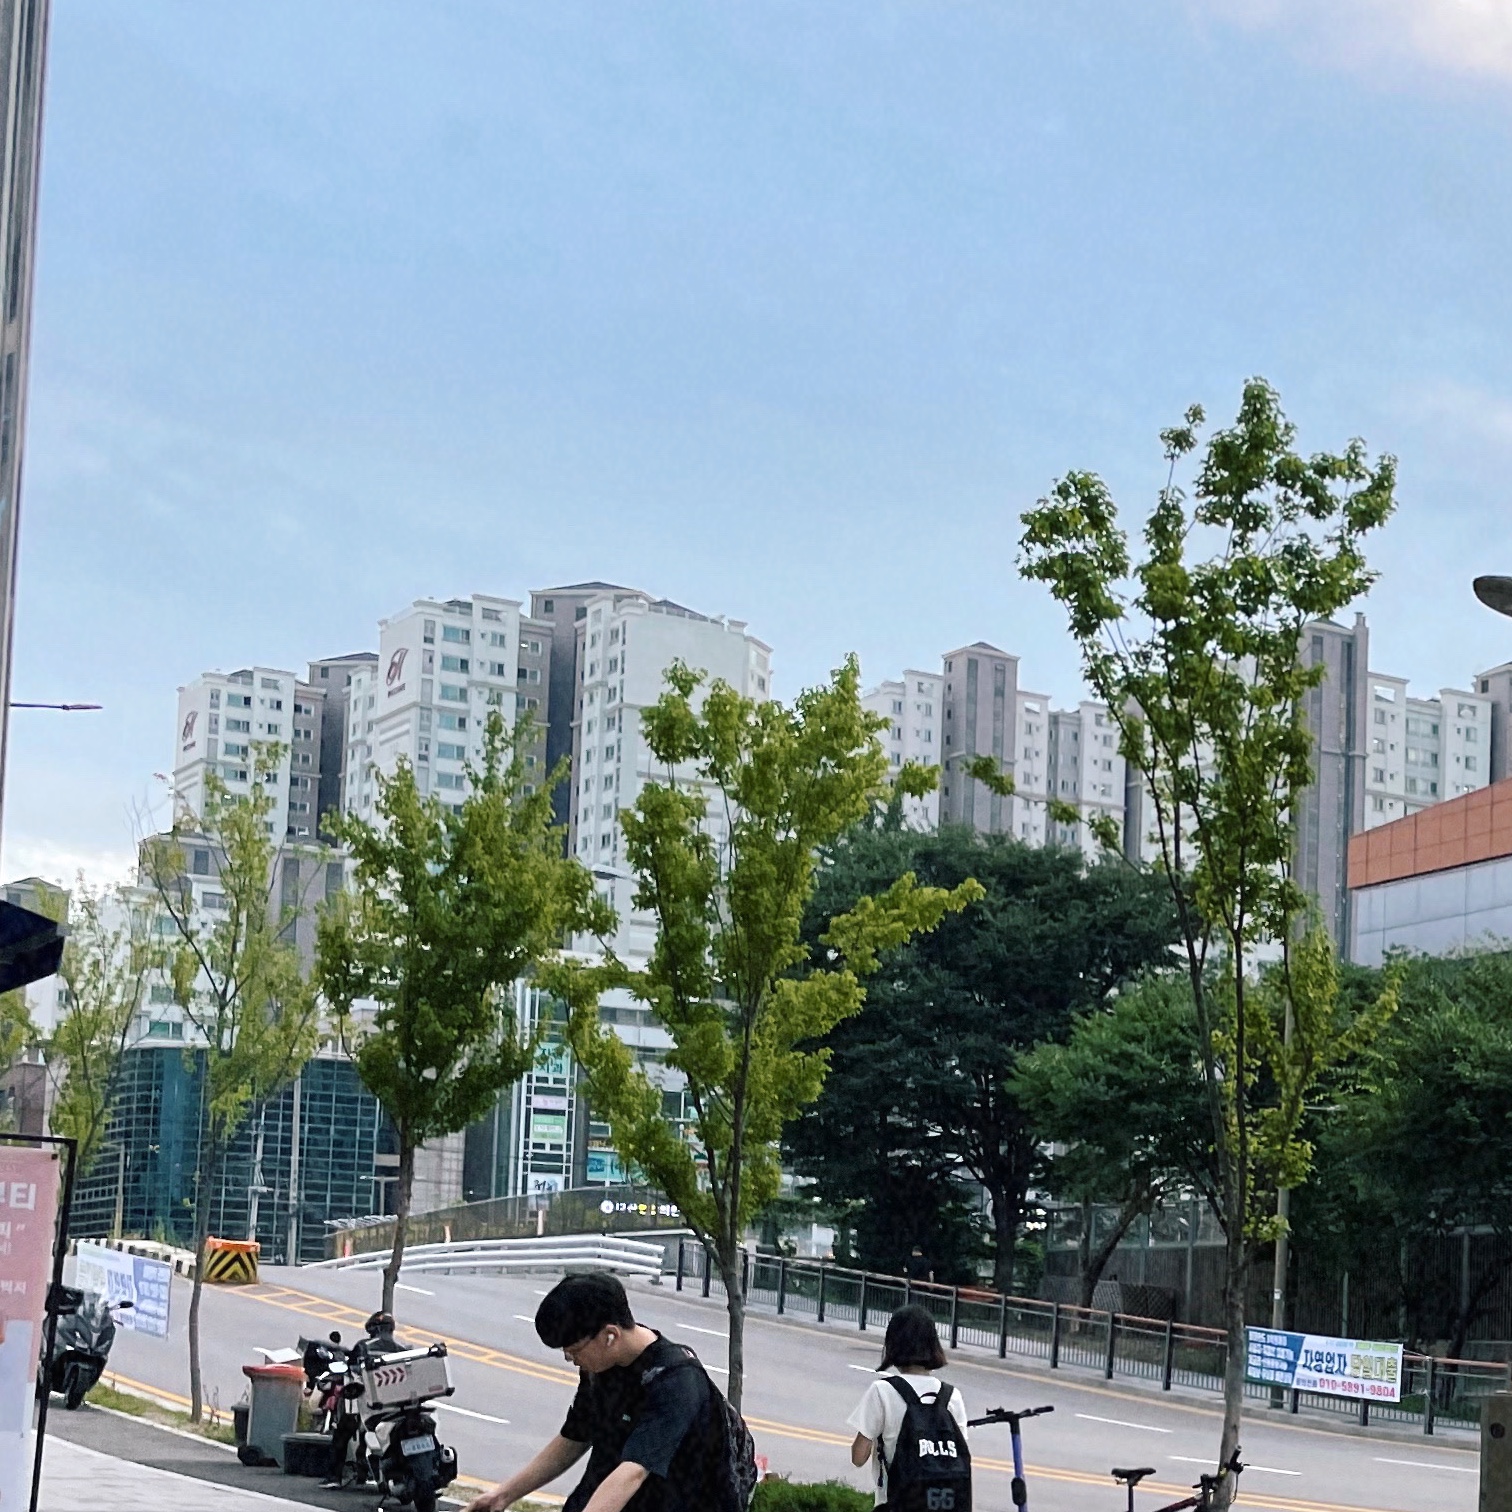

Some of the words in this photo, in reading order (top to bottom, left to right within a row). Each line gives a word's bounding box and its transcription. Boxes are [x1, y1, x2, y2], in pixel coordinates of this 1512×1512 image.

[0, 1182, 37, 1211] 티
[1303, 1349, 1347, 1376] 자영업자
[919, 1438, 957, 1458] BULLS
